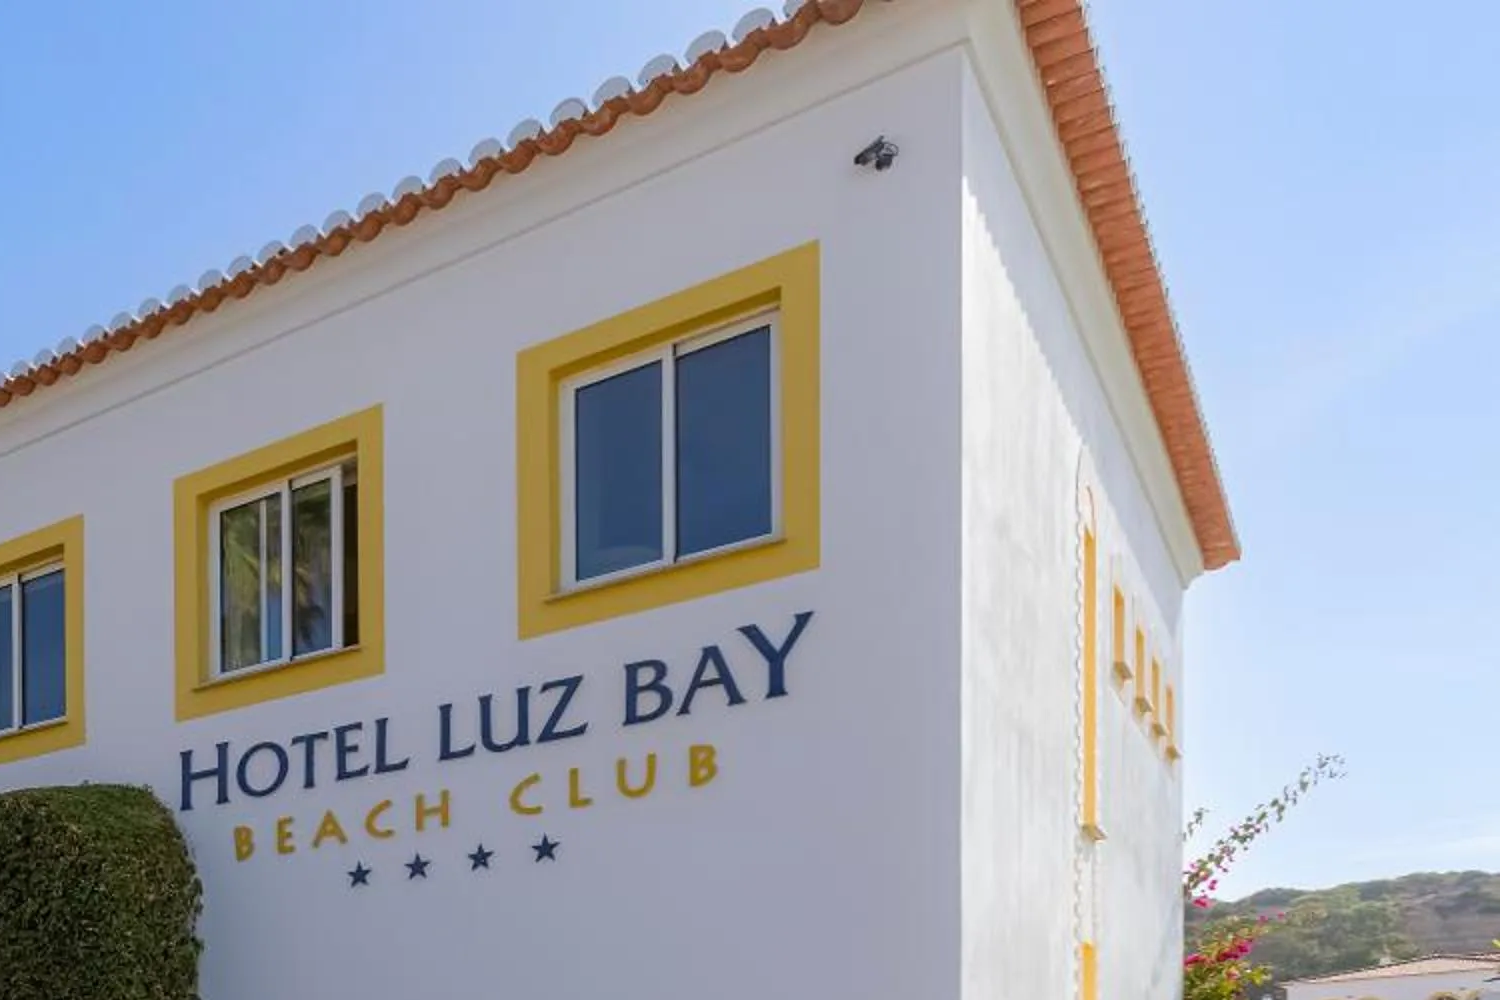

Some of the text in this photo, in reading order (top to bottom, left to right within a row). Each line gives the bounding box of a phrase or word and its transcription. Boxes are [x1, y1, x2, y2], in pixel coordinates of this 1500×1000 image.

[178, 610, 815, 812] HOTEL LUZ BAY
[234, 743, 719, 862] BEACH CLUB
